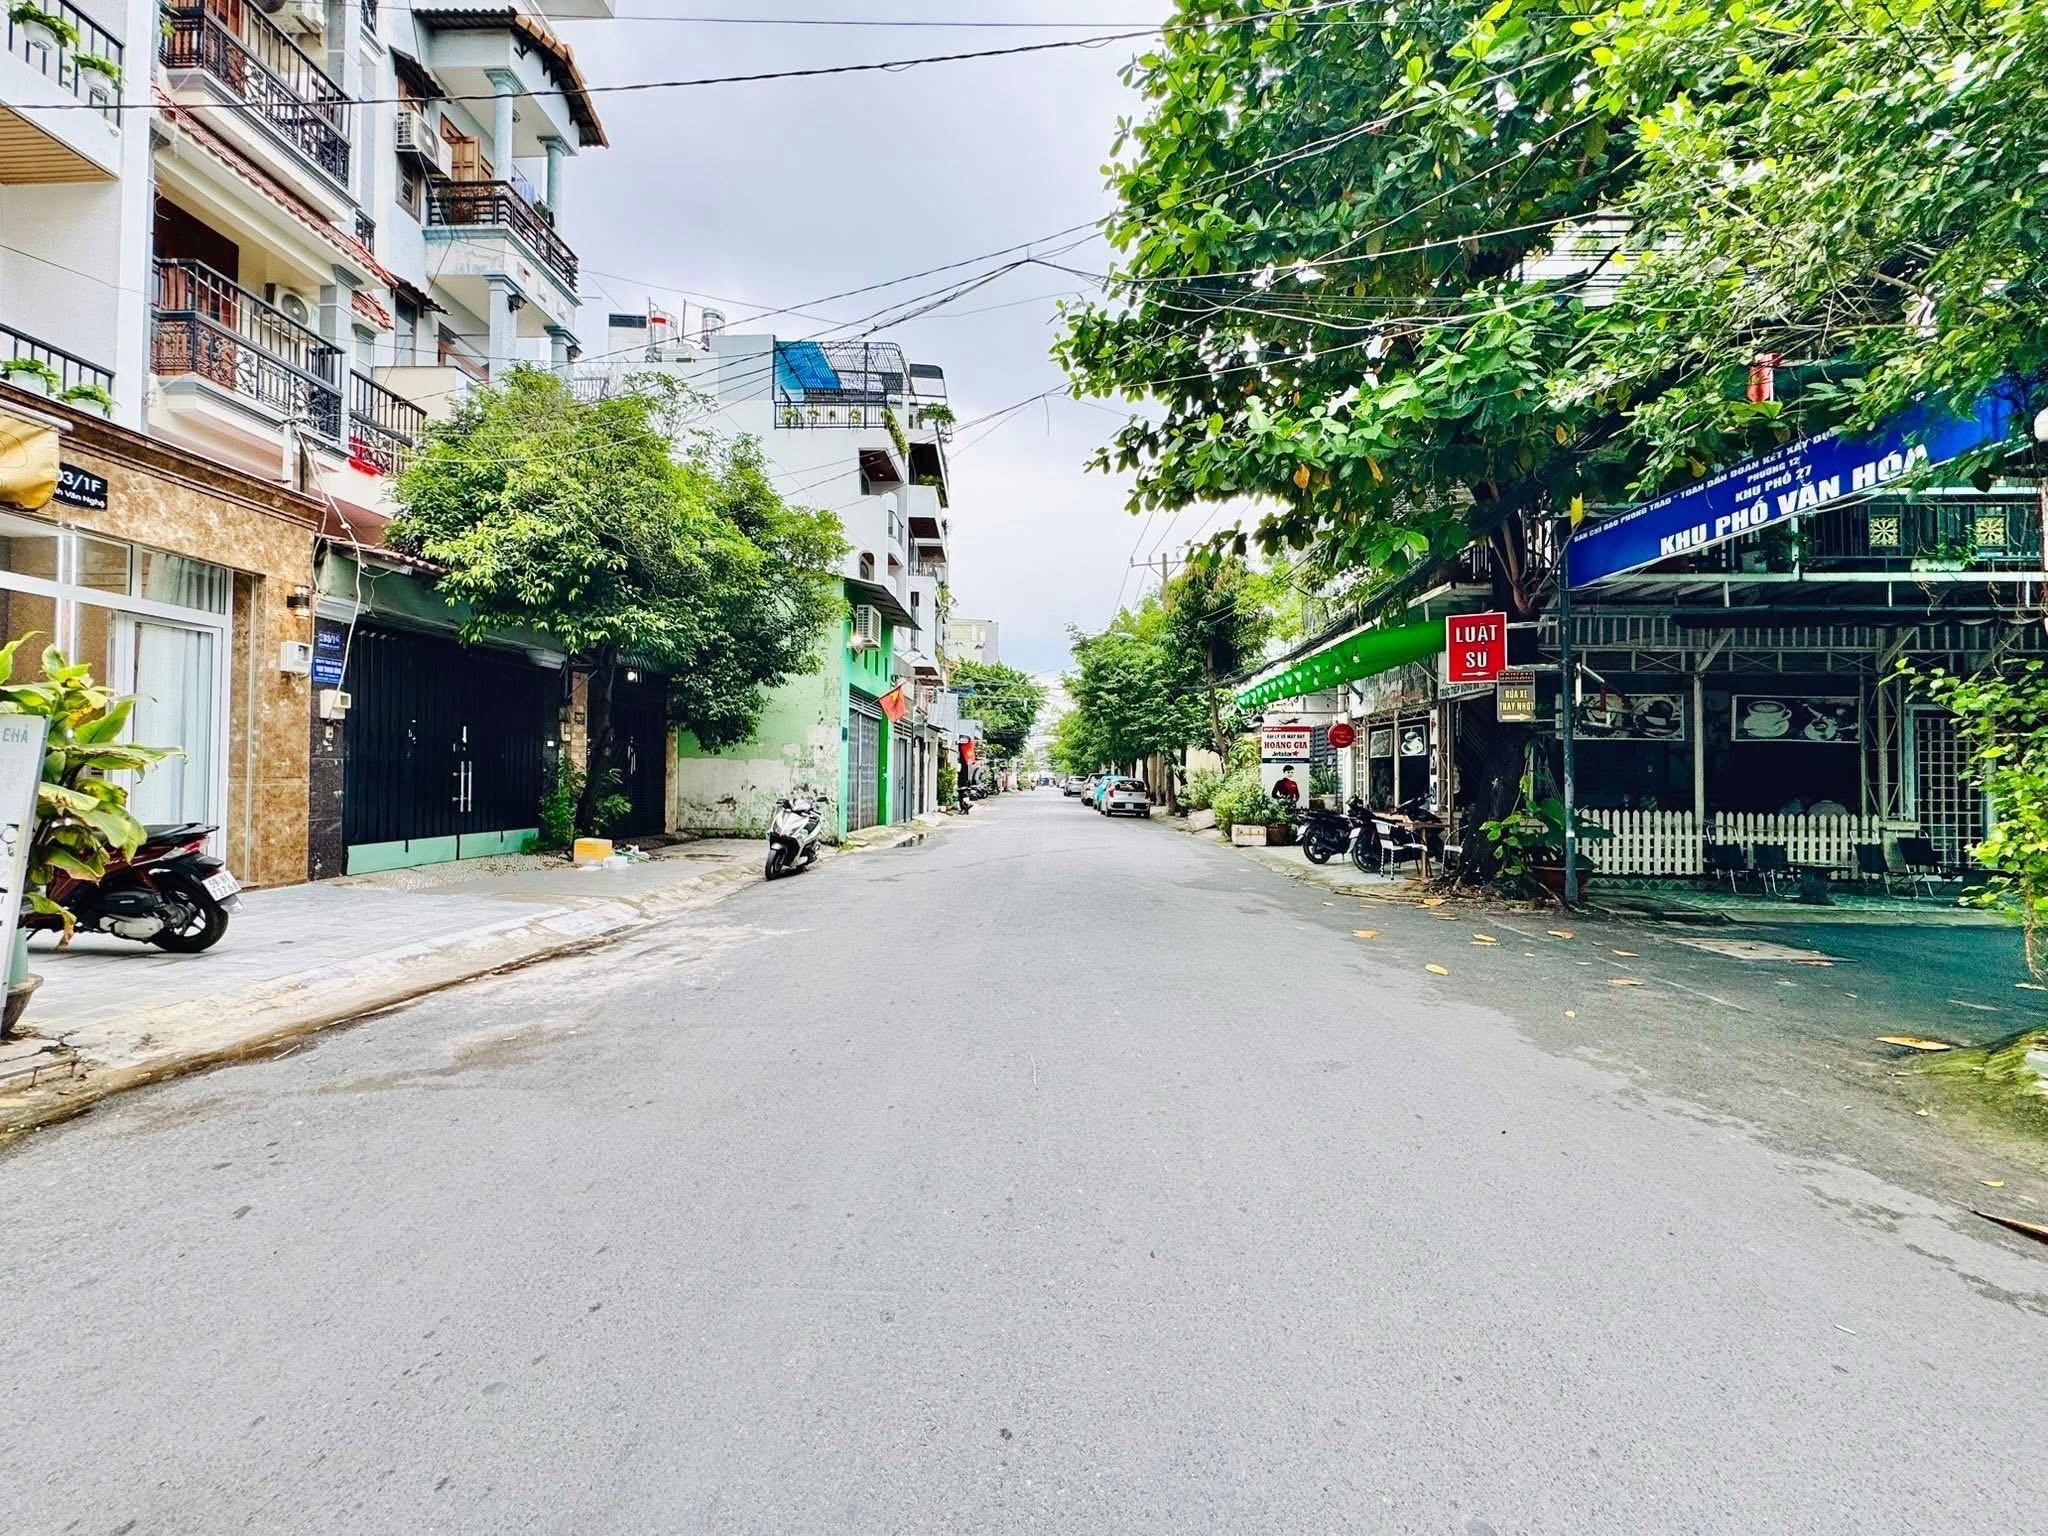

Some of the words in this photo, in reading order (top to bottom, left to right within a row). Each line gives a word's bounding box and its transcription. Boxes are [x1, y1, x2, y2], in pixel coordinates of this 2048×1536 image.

[1735, 484, 1761, 503] KHU
[1795, 464, 1812, 480] 27
[1660, 523, 1707, 556] KHU
[1715, 495, 1769, 538] PHỐ
[1777, 479, 1840, 516] VĂN
[1852, 443, 1928, 492] HÓA
[1519, 690, 1529, 699] XE
[1294, 741, 1308, 749] GIA
